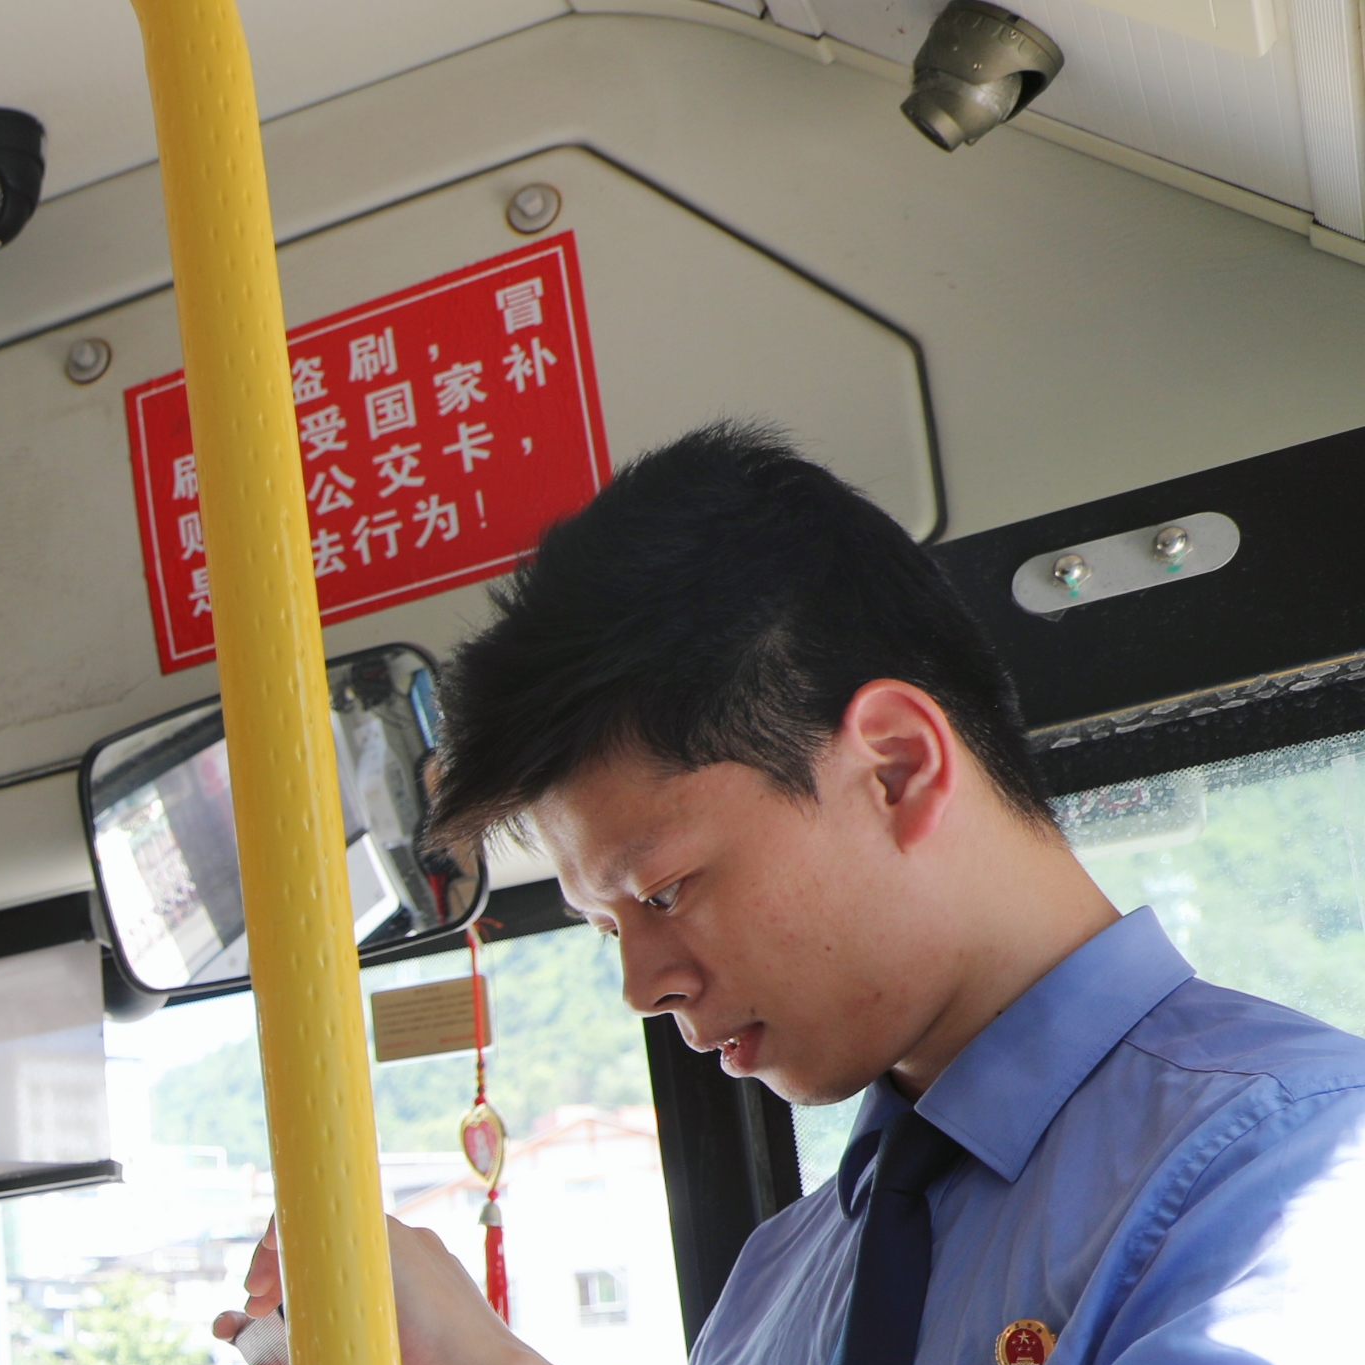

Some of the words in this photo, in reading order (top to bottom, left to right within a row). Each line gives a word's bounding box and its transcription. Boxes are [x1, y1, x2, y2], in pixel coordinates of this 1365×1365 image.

[172, 337, 557, 500] 刷受国家补
[178, 423, 533, 560] 公交卡，
[188, 490, 488, 617] 是法行为！
